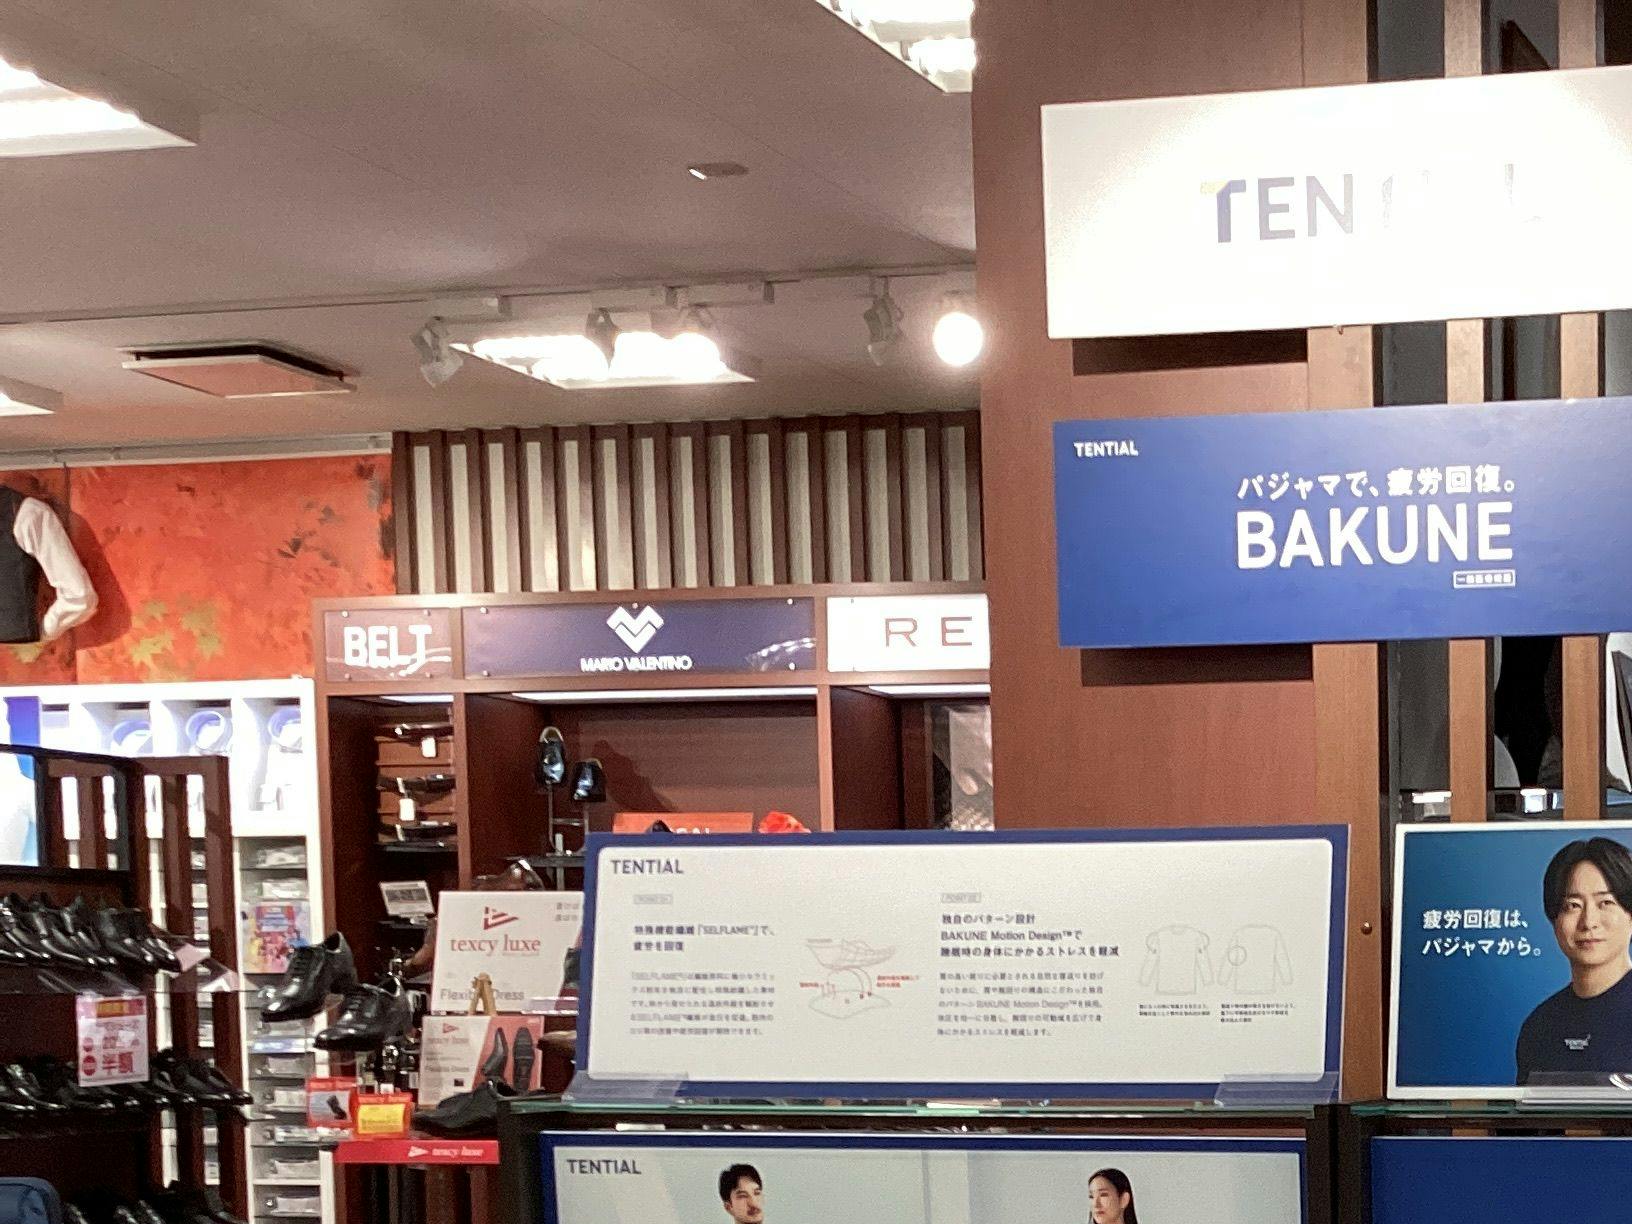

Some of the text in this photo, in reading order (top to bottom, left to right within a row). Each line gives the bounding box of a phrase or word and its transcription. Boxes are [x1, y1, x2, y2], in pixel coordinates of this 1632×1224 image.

[1074, 441, 1139, 457] TENTIAL
[1237, 464, 1515, 500] パジャマで、疲労回復。
[1236, 501, 1514, 569] BAKUNE
[343, 624, 431, 668] BELT
[580, 655, 692, 672] MARIO VALENTINO
[610, 858, 685, 874] TENTIAL
[1423, 909, 1528, 929] 疲労回復は、
[450, 933, 541, 956] texcy luxe
[940, 930, 987, 941] BAKUNE
[991, 930, 1026, 941] Motion
[1422, 937, 1541, 956] パジャマから。
[566, 1159, 642, 1174] TENTIAL
